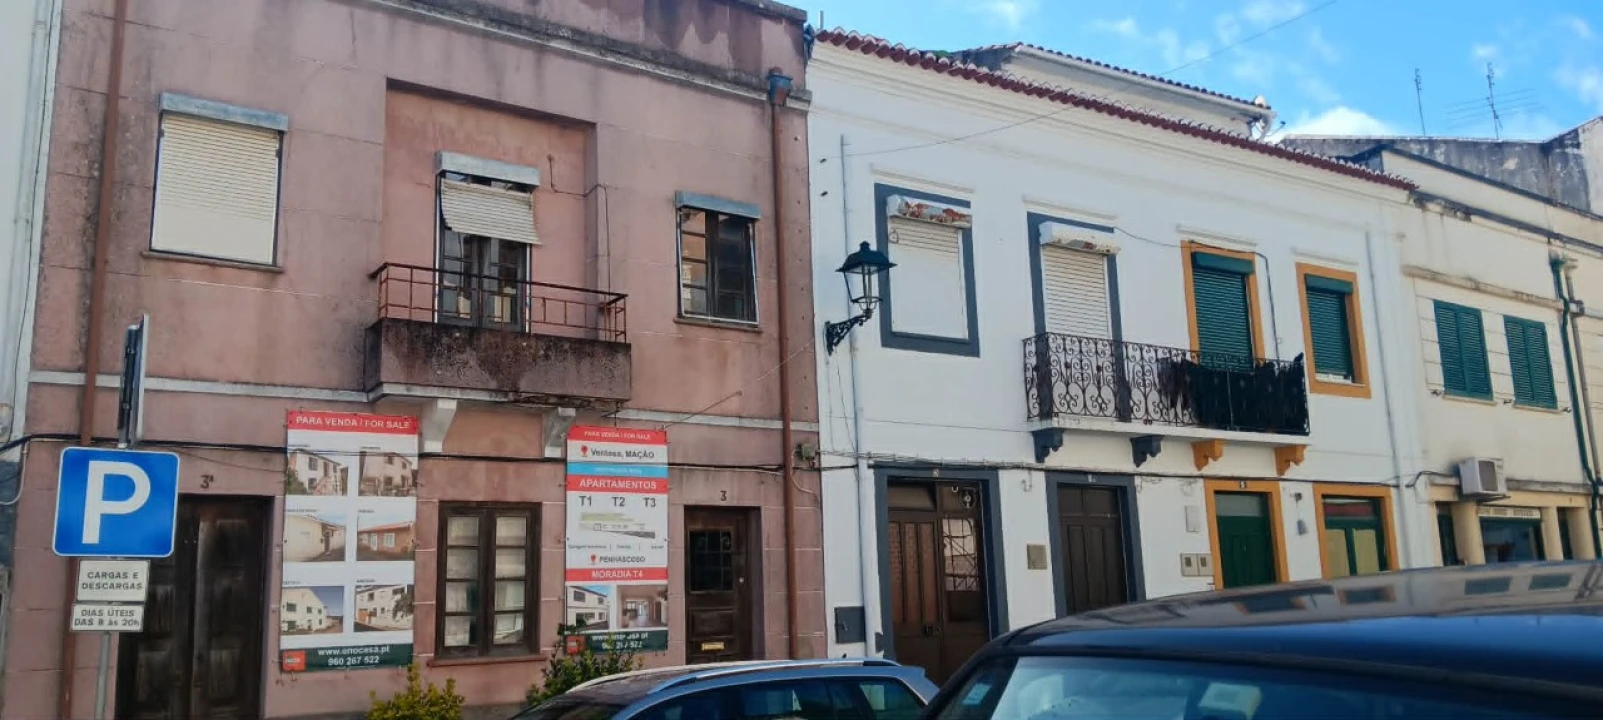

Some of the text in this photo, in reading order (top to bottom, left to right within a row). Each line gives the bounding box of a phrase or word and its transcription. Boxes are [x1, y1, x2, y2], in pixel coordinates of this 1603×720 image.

[296, 416, 323, 424] PARA
[326, 418, 358, 427] VENDA
[365, 420, 384, 428] FOR
[386, 421, 412, 429] SALE
[625, 449, 655, 459] MAÇÃO
[579, 479, 657, 490] APARTAMENTOS
[720, 490, 727, 501] 3
[82, 460, 150, 544] P
[579, 495, 656, 508] T1 T2 T3
[600, 555, 646, 563] PENHASCOSO
[87, 571, 139, 580] CARGAS E
[591, 570, 632, 578] MORADIA
[81, 582, 143, 590] DESCARGAS
[81, 606, 135, 618] DIAS ÚTEIS
[74, 618, 94, 626] DAS
[122, 618, 140, 627] 20h
[327, 656, 379, 666] 960 267 522
